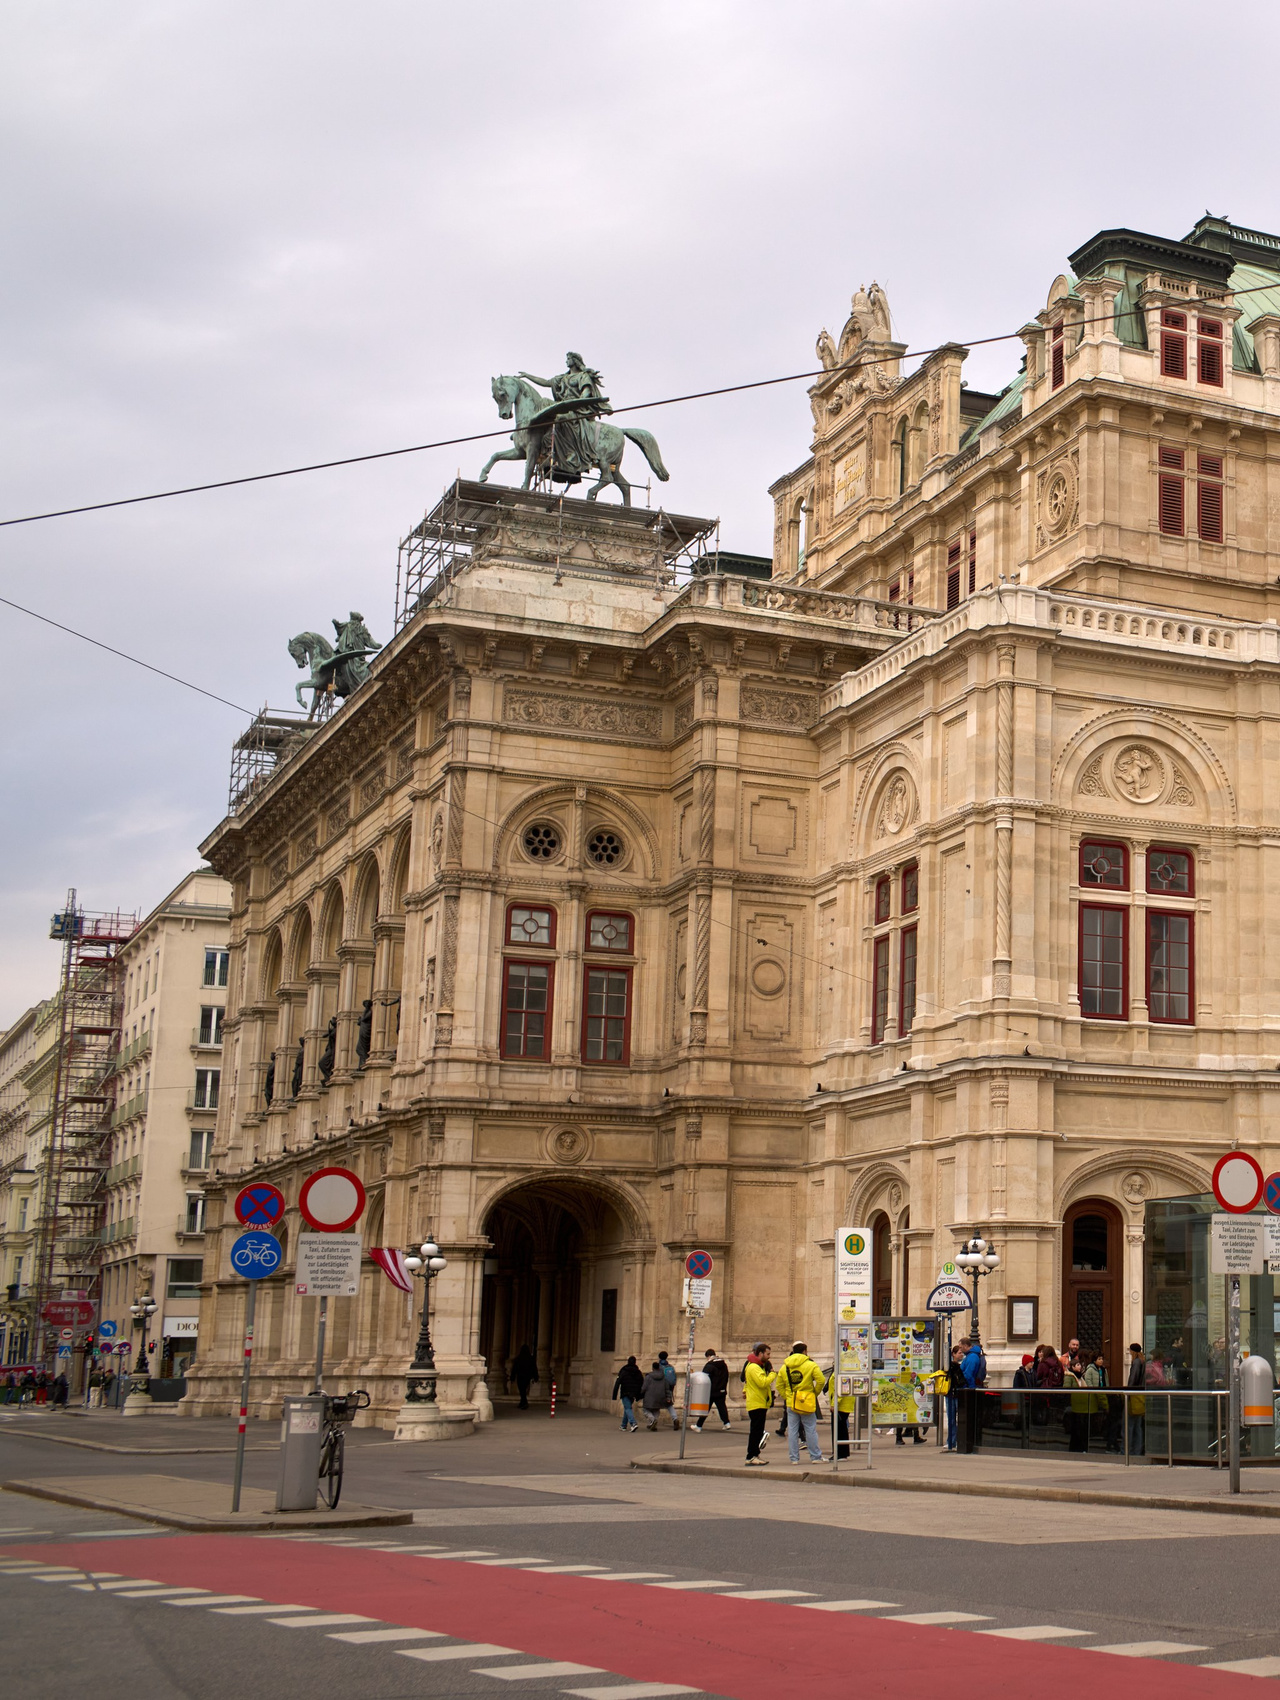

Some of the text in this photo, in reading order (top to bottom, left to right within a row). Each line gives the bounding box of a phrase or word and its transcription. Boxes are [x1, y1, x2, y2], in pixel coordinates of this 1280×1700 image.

[244, 1221, 273, 1230] ANFANG
[849, 1238, 860, 1251] H
[937, 1286, 962, 1296] AUTOBUS
